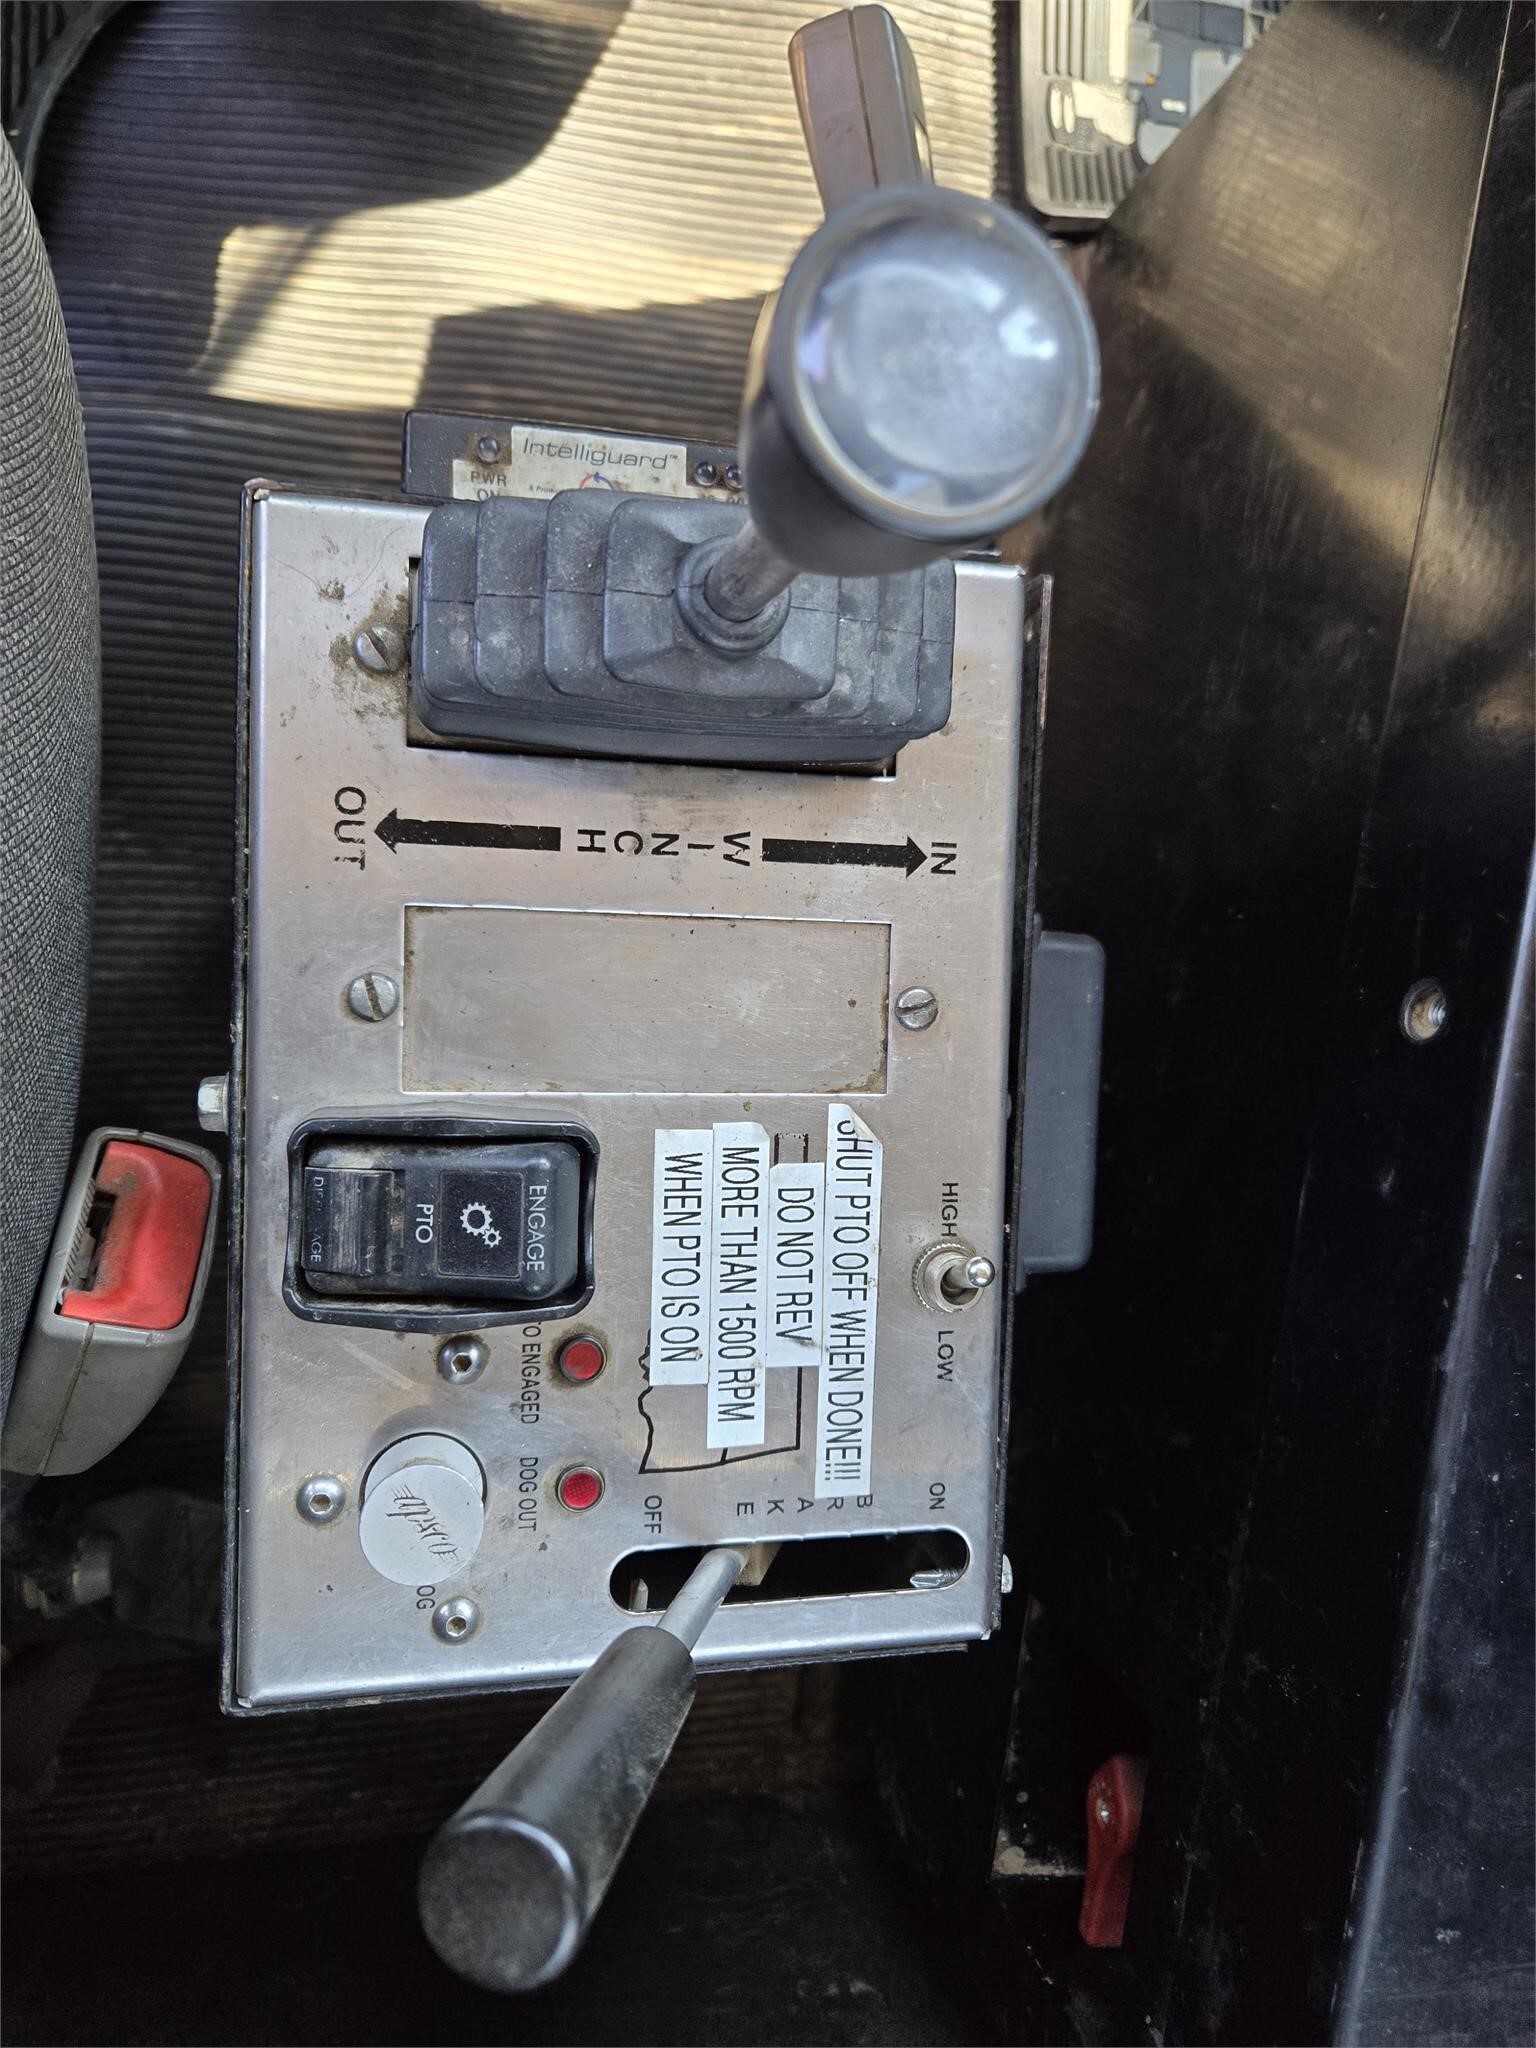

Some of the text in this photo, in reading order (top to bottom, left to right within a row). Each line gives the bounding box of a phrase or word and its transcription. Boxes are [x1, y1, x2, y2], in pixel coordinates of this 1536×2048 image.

[470, 471, 507, 487] PWR
[334, 786, 367, 871] OUT
[576, 828, 752, 867] WINCH
[930, 841, 957, 876] IN
[310, 1176, 324, 1263] DIAGE
[414, 1203, 435, 1244] PTO
[526, 1184, 548, 1272] ENGAGE
[833, 1195, 871, 1244] PTO
[940, 1182, 959, 1238] HIGH
[659, 1152, 703, 1363] WHEN PTO IS ON
[717, 1147, 760, 1423] MORE THAN 1500 RPM
[775, 1187, 815, 1341] DO NOT REV
[831, 1252, 870, 1301] OFF
[828, 1308, 867, 1383] WHEN
[936, 1329, 955, 1383] LOW
[520, 1342, 542, 1425] ENGAGED
[824, 1391, 864, 1481] DONE!!!
[517, 1456, 539, 1532] DOG OUT
[643, 1495, 663, 1534] OFF
[736, 1493, 874, 1517] BRAKE
[929, 1481, 946, 1511] ON
[416, 1584, 436, 1611] OG
